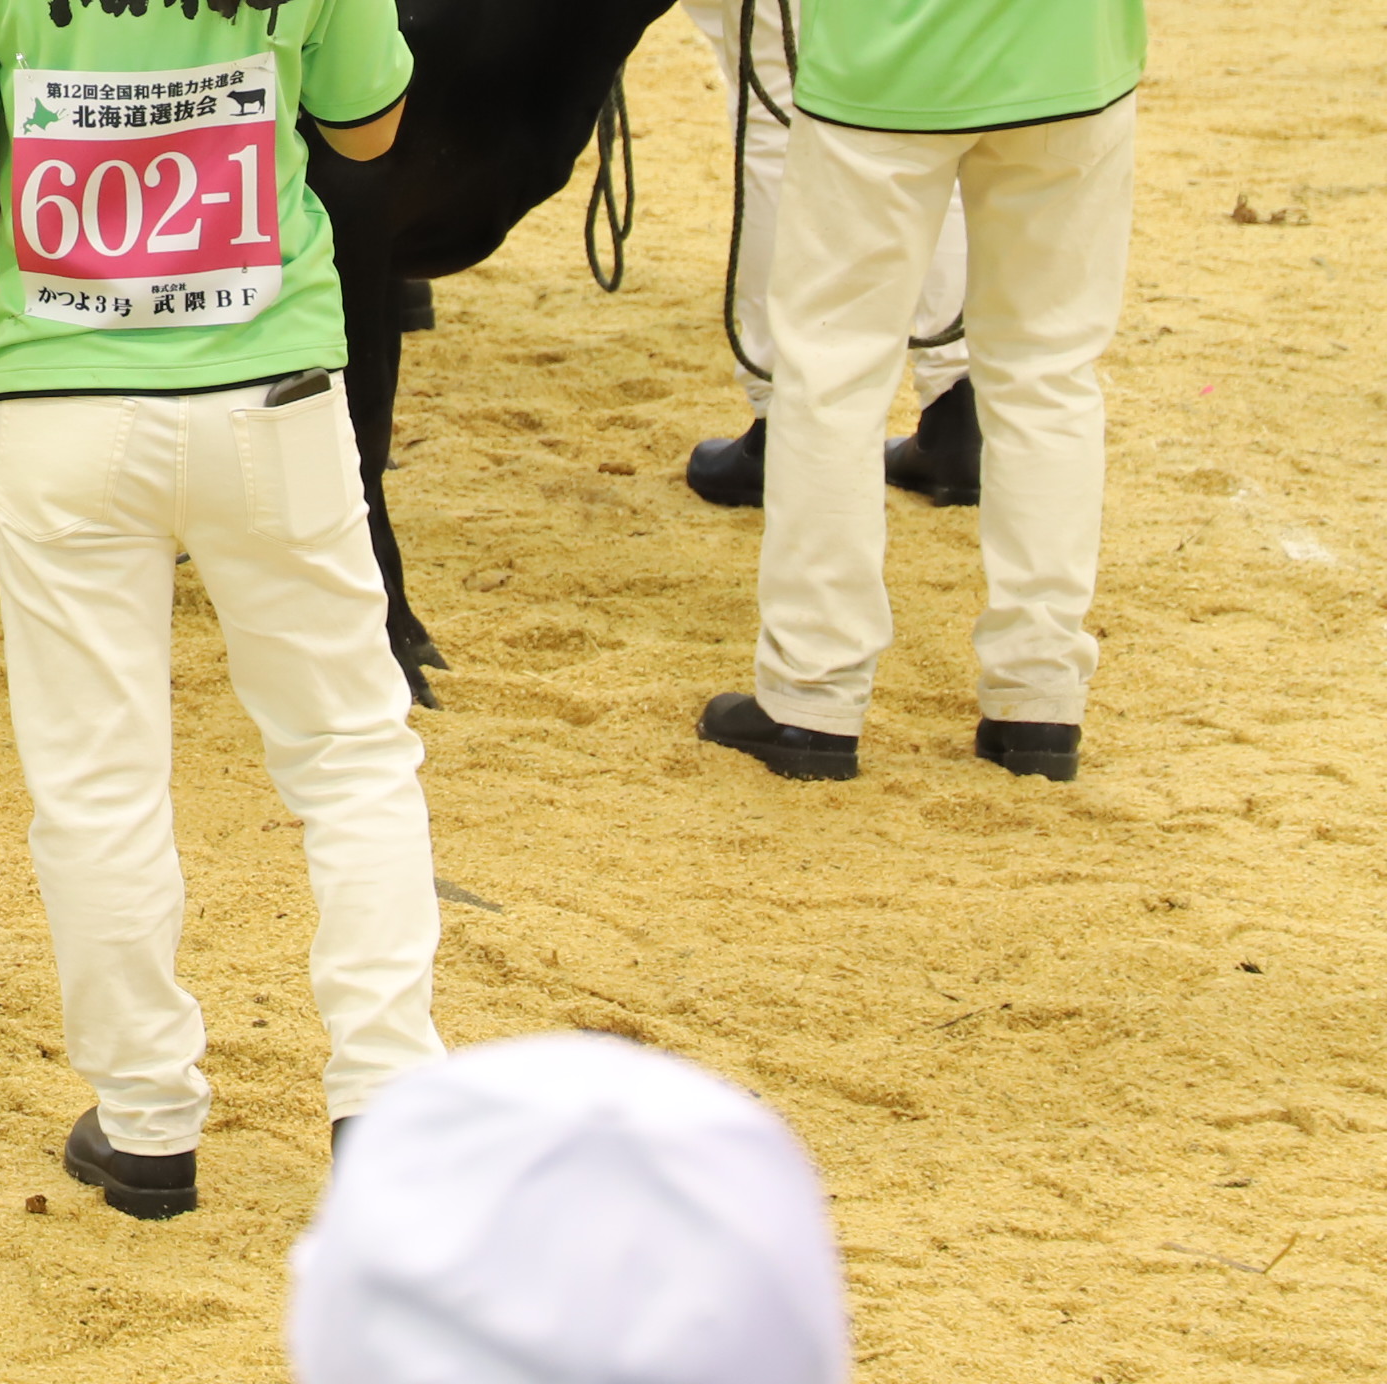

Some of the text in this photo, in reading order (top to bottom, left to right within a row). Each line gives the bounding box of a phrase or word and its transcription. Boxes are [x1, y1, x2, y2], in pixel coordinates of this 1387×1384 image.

[46, 70, 245, 101] 第12回全国和牛能力共進会
[72, 95, 218, 129] 北海道選抜会
[20, 144, 271, 260] 602-1
[38, 286, 133, 318] かつよ3号
[151, 282, 187, 294] 株式会社
